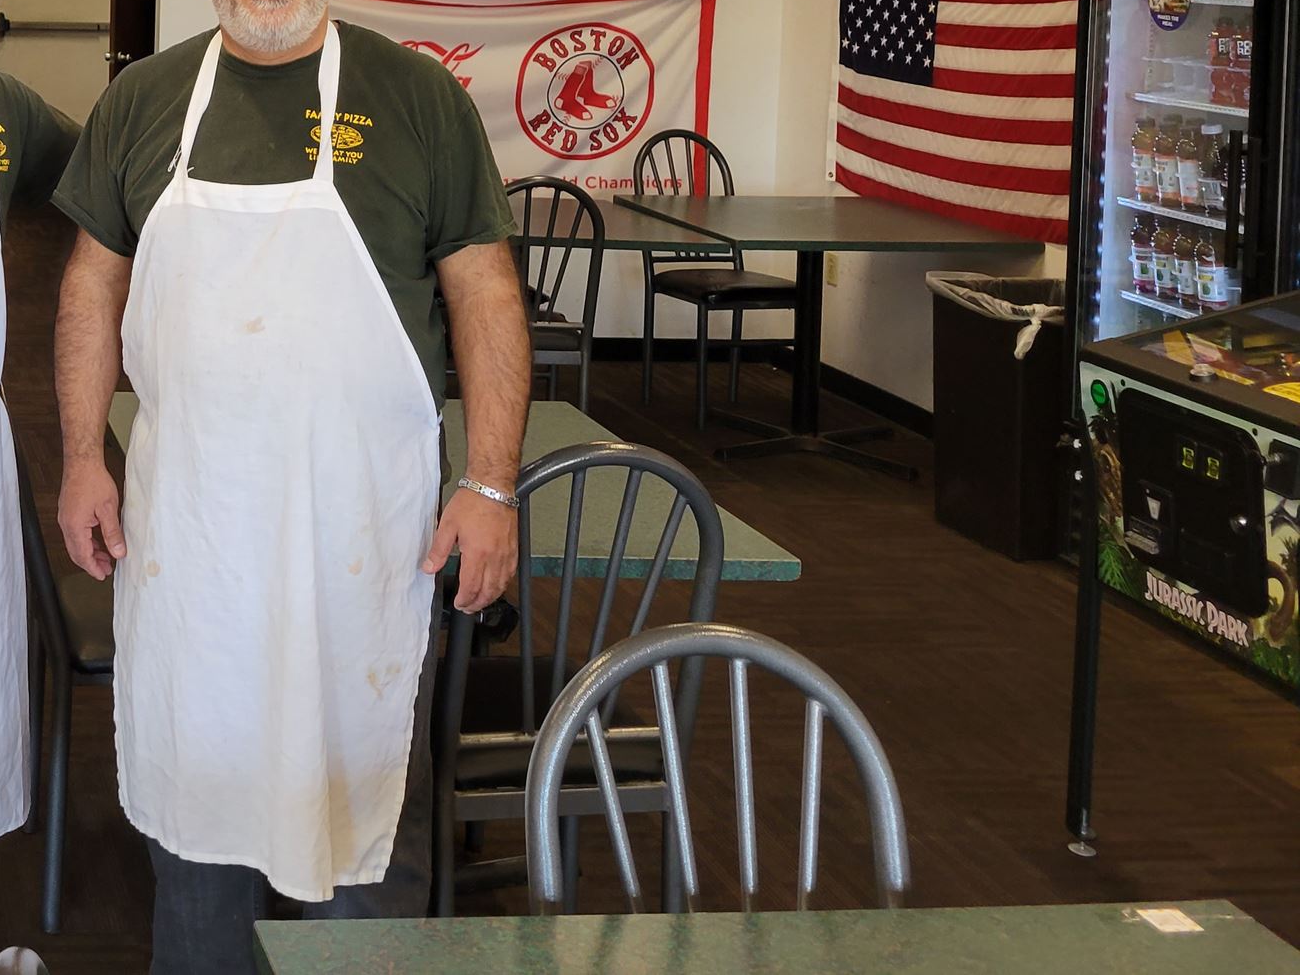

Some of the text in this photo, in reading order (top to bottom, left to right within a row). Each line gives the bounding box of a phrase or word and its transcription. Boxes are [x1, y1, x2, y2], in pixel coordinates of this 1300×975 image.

[533, 29, 640, 73] BOSTON
[305, 109, 373, 127] FAY PIZZA
[528, 107, 638, 153] RED SOX
[305, 147, 318, 155] WE
[346, 151, 364, 159] YOU
[332, 156, 358, 164] AMILY
[585, 177, 682, 189] Chamions
[1144, 571, 1249, 647] JURASSIC PARK
